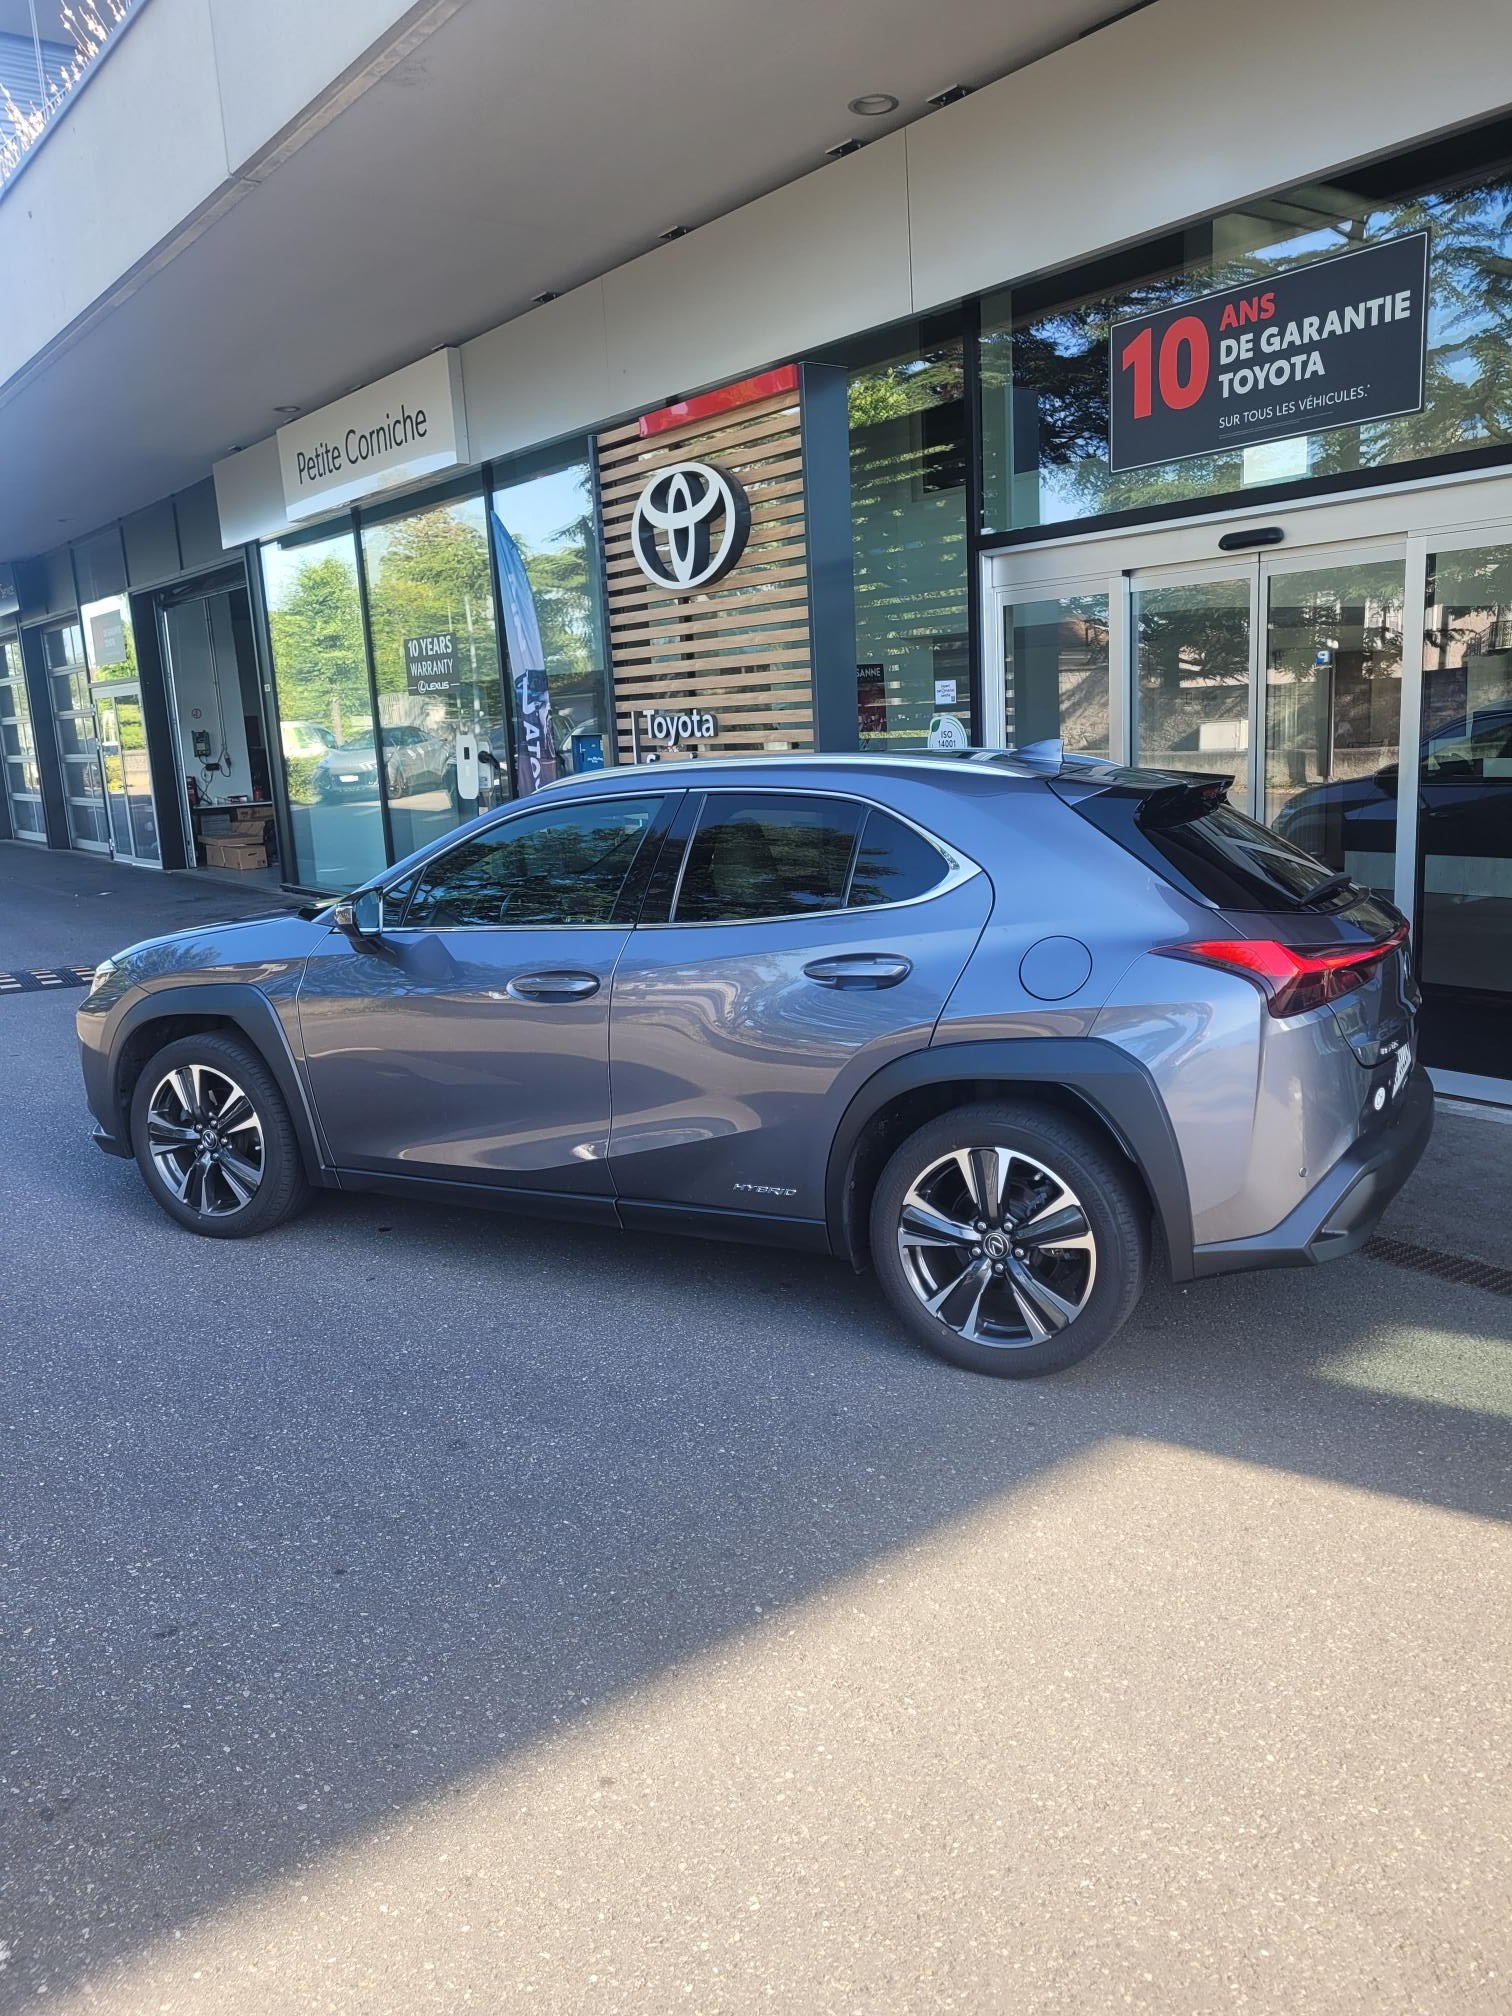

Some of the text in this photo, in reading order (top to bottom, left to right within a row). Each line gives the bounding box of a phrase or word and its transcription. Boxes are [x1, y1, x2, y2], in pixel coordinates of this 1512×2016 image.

[1219, 292, 1276, 332] ANS
[1219, 290, 1411, 365] DE GARANTIE
[1122, 315, 1210, 420] 10
[1218, 350, 1326, 399] TOYOTA
[1219, 414, 1240, 429] SUR
[1242, 406, 1273, 422] TOUS
[1276, 401, 1296, 416] LES
[296, 404, 428, 485] Petite Corniche
[407, 635, 453, 657] 10 YEARS
[410, 658, 453, 677] WARRANTY
[426, 681, 450, 691] LEXUS
[642, 708, 714, 747] Toyota
[941, 730, 953, 739] ISO
[938, 739, 956, 748] 14001
[732, 1183, 797, 1196] HYBRID
